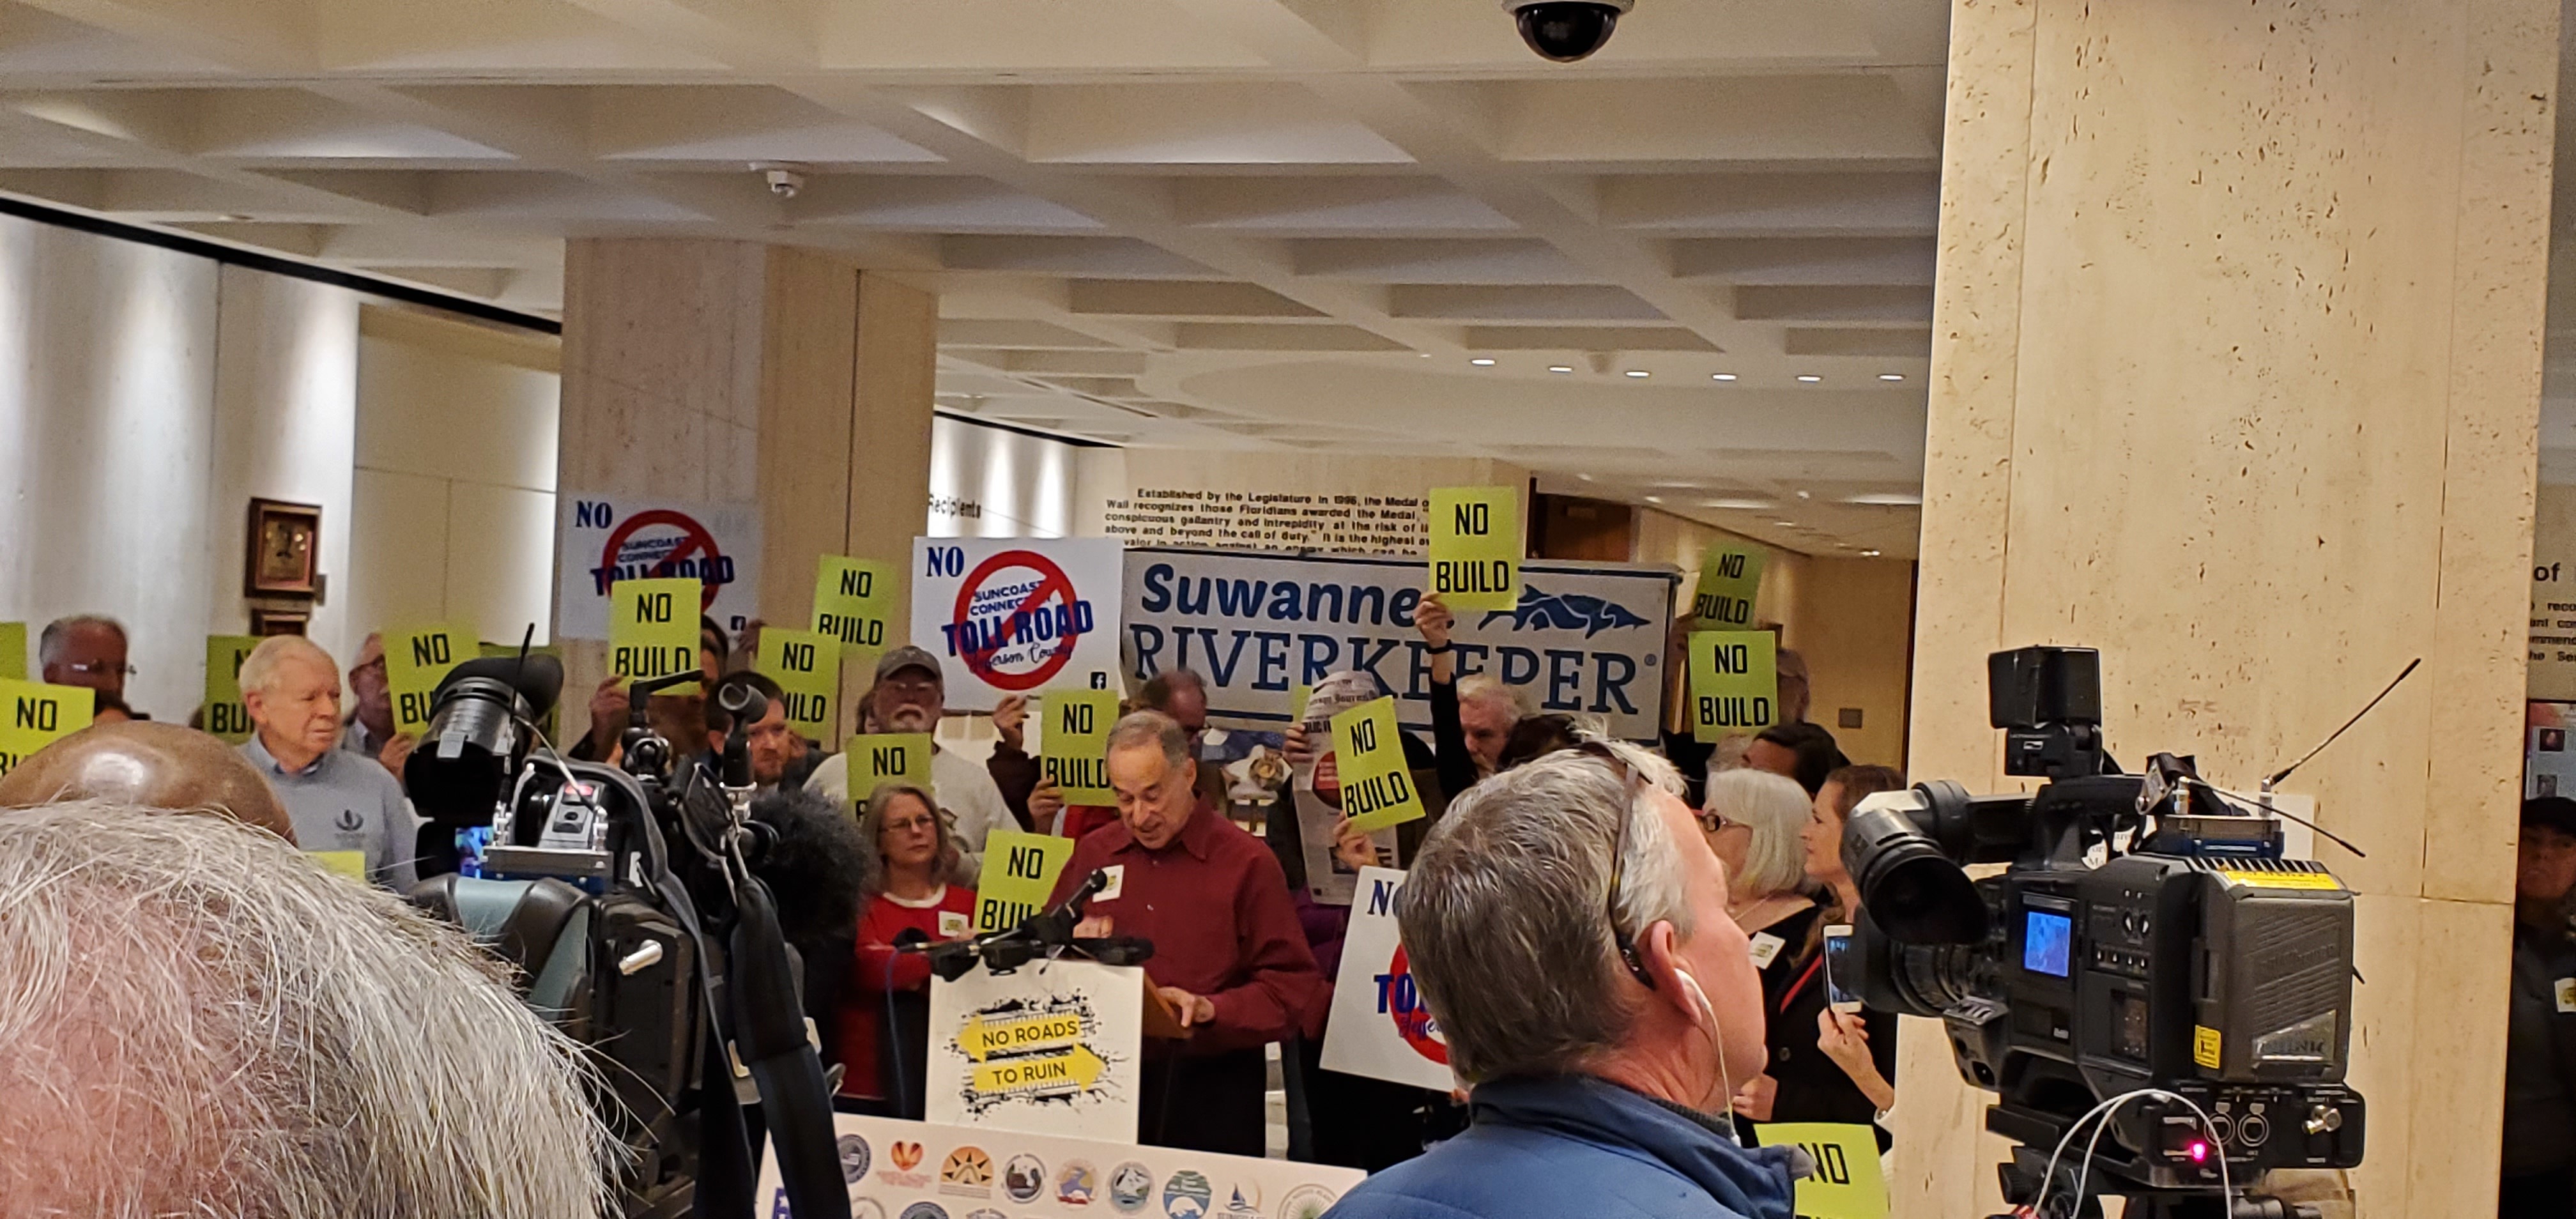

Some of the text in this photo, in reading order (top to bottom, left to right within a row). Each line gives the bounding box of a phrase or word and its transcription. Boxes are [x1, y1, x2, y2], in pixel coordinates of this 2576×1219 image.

[576, 500, 612, 529] NO
[1107, 500, 1129, 509] Wall
[1134, 503, 1193, 512] recognizes
[1200, 504, 1232, 512] those
[1240, 504, 1297, 516] Floridians
[1302, 509, 1350, 518] awarded
[1357, 509, 1375, 518] the
[1207, 491, 1221, 503] by
[1225, 493, 1243, 501] the
[1248, 492, 1311, 504] Legislature
[1318, 494, 1328, 503] in
[1365, 497, 1381, 506] the
[1385, 497, 1418, 507] Medal
[1105, 513, 1174, 523] conspicuous
[1181, 516, 1230, 527] gallantry
[1264, 519, 1324, 531] intrepidity
[1333, 521, 1344, 530] at
[1352, 521, 1370, 530] the
[1375, 522, 1397, 531] risk
[1402, 523, 1415, 532] of
[1455, 503, 1489, 535] NO
[1105, 525, 1137, 534] above
[1142, 526, 1163, 535] and
[1170, 526, 1213, 539] beyond
[1218, 529, 1238, 537] the
[1241, 530, 1261, 539] call
[1264, 530, 1276, 540] of
[1349, 534, 1368, 543] the
[1370, 535, 1414, 546] highest
[1124, 538, 1151, 547] valor
[926, 546, 964, 577] NO
[1436, 559, 1509, 593] BUILD
[1717, 553, 1745, 579] NO
[2534, 562, 2561, 582] of
[840, 569, 872, 598] NO
[1142, 563, 1454, 629] Suwanne
[637, 593, 671, 623] NO
[1695, 593, 1749, 624] BUILD
[818, 613, 884, 646] BUILD
[941, 600, 1094, 657] TOLL ROAD
[413, 633, 450, 667] NO
[615, 647, 691, 677] BUILD
[782, 641, 815, 672] NO
[1714, 644, 1748, 674] NO
[1129, 624, 1638, 716] RIVERKEEPER
[17, 695, 58, 732] NO
[1062, 703, 1093, 734] NO
[1699, 697, 1770, 727] BUILD
[1350, 717, 1377, 757] NO
[872, 746, 906, 776] NO
[1046, 757, 1110, 788] BUILD
[1344, 771, 1410, 818] BUILD
[1007, 846, 1044, 880] NO
[983, 1020, 1078, 1048] NO ROADS
[992, 1061, 1067, 1086] TO RUIN
[1797, 1142, 1850, 1184] NO
